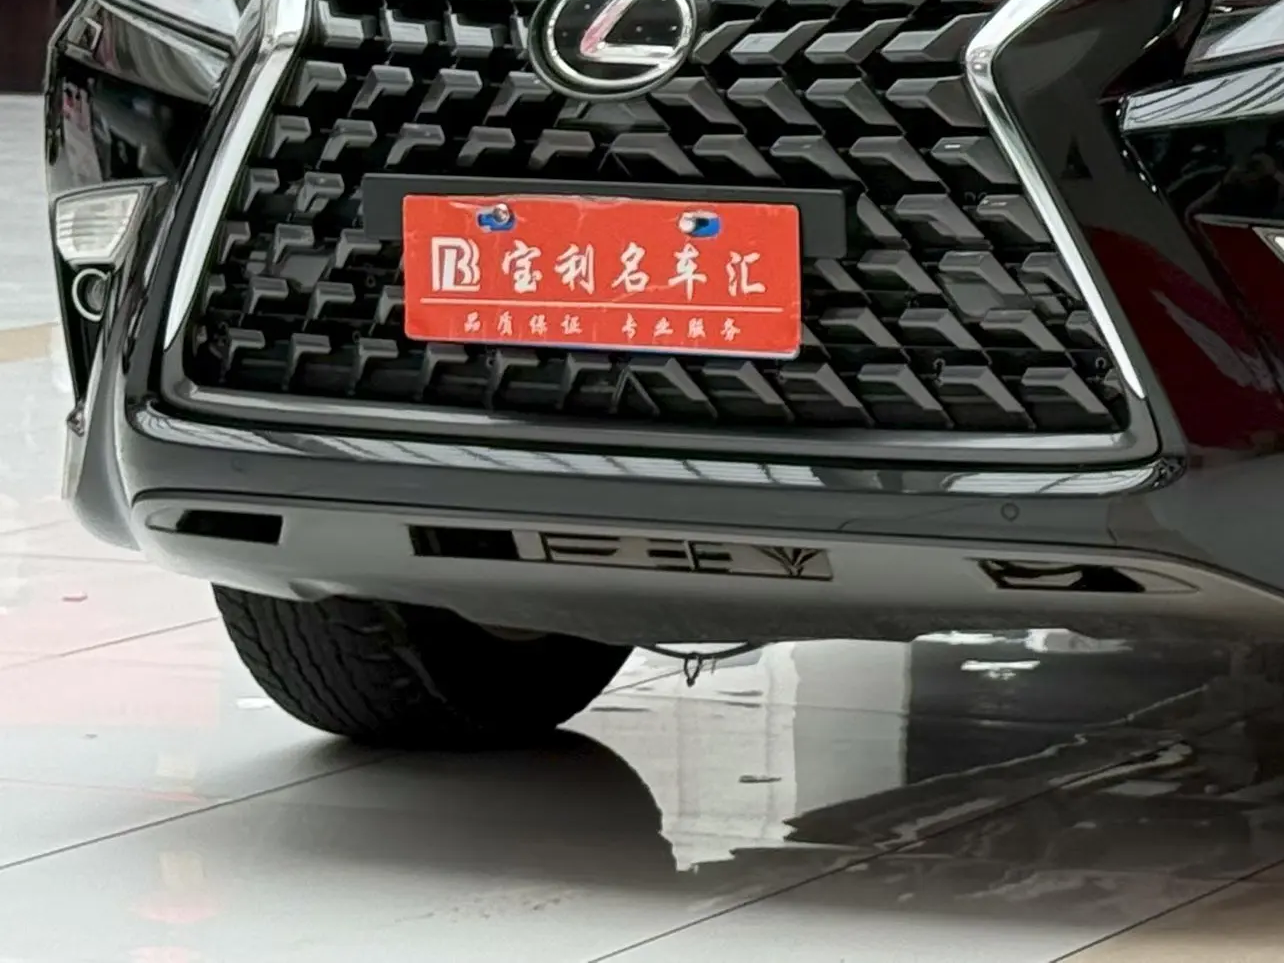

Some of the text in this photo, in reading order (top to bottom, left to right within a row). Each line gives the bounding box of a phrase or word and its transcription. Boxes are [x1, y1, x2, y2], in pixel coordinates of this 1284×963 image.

[501, 239, 767, 301] 宝利名车汇
[463, 311, 742, 341] 品质保证 专业服务
